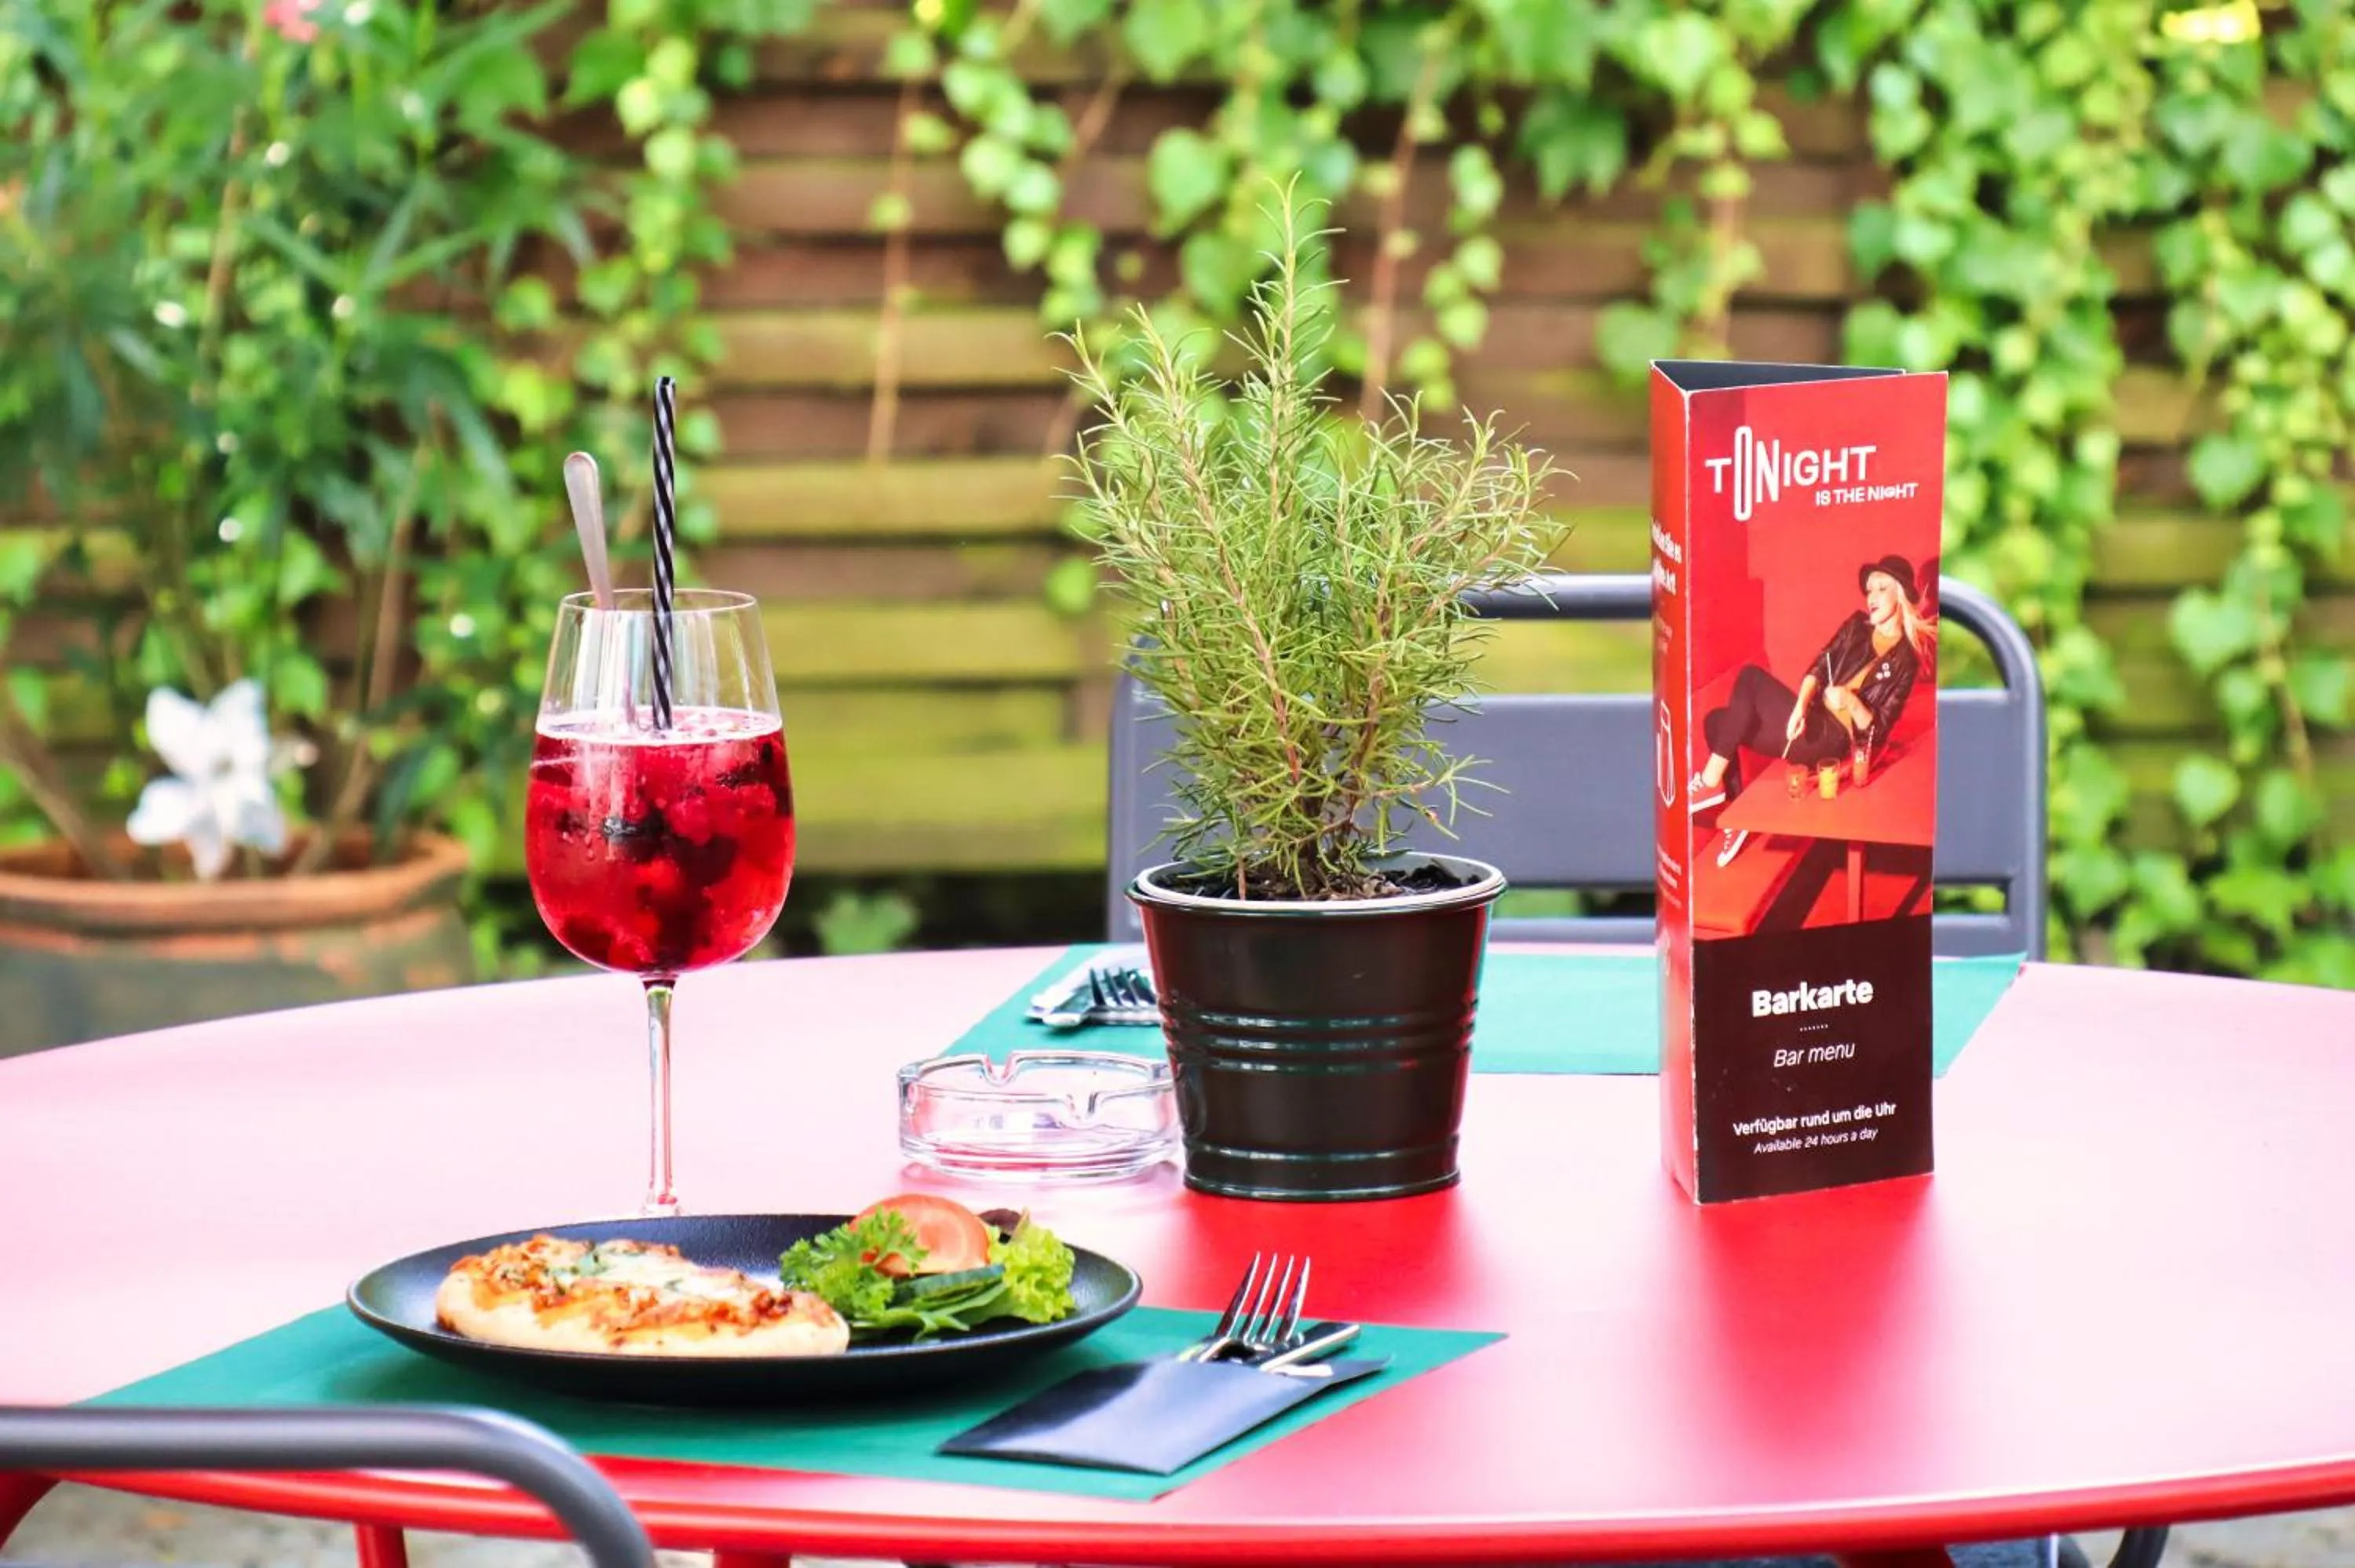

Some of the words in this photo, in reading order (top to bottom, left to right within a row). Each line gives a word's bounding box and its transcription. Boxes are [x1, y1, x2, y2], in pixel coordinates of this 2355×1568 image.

[1705, 426, 1876, 521] TONIGHT
[1816, 489, 1831, 505] IS
[1833, 487, 1865, 504] THE
[1868, 483, 1919, 501] NIGHT
[1752, 979, 1874, 1017] Barkarte
[1773, 1049, 1804, 1067] Bar
[1808, 1042, 1856, 1064] menu
[1732, 1115, 1798, 1136] Verfügbar
[1800, 1110, 1830, 1128] rund
[1831, 1109, 1852, 1123] um
[1853, 1105, 1872, 1119] die
[1875, 1101, 1897, 1118] Uhr
[1754, 1137, 1802, 1154] Available
[1805, 1136, 1818, 1149] 24
[1820, 1131, 1849, 1146] hours
[1850, 1131, 1857, 1142] a
[1860, 1127, 1879, 1143] day
